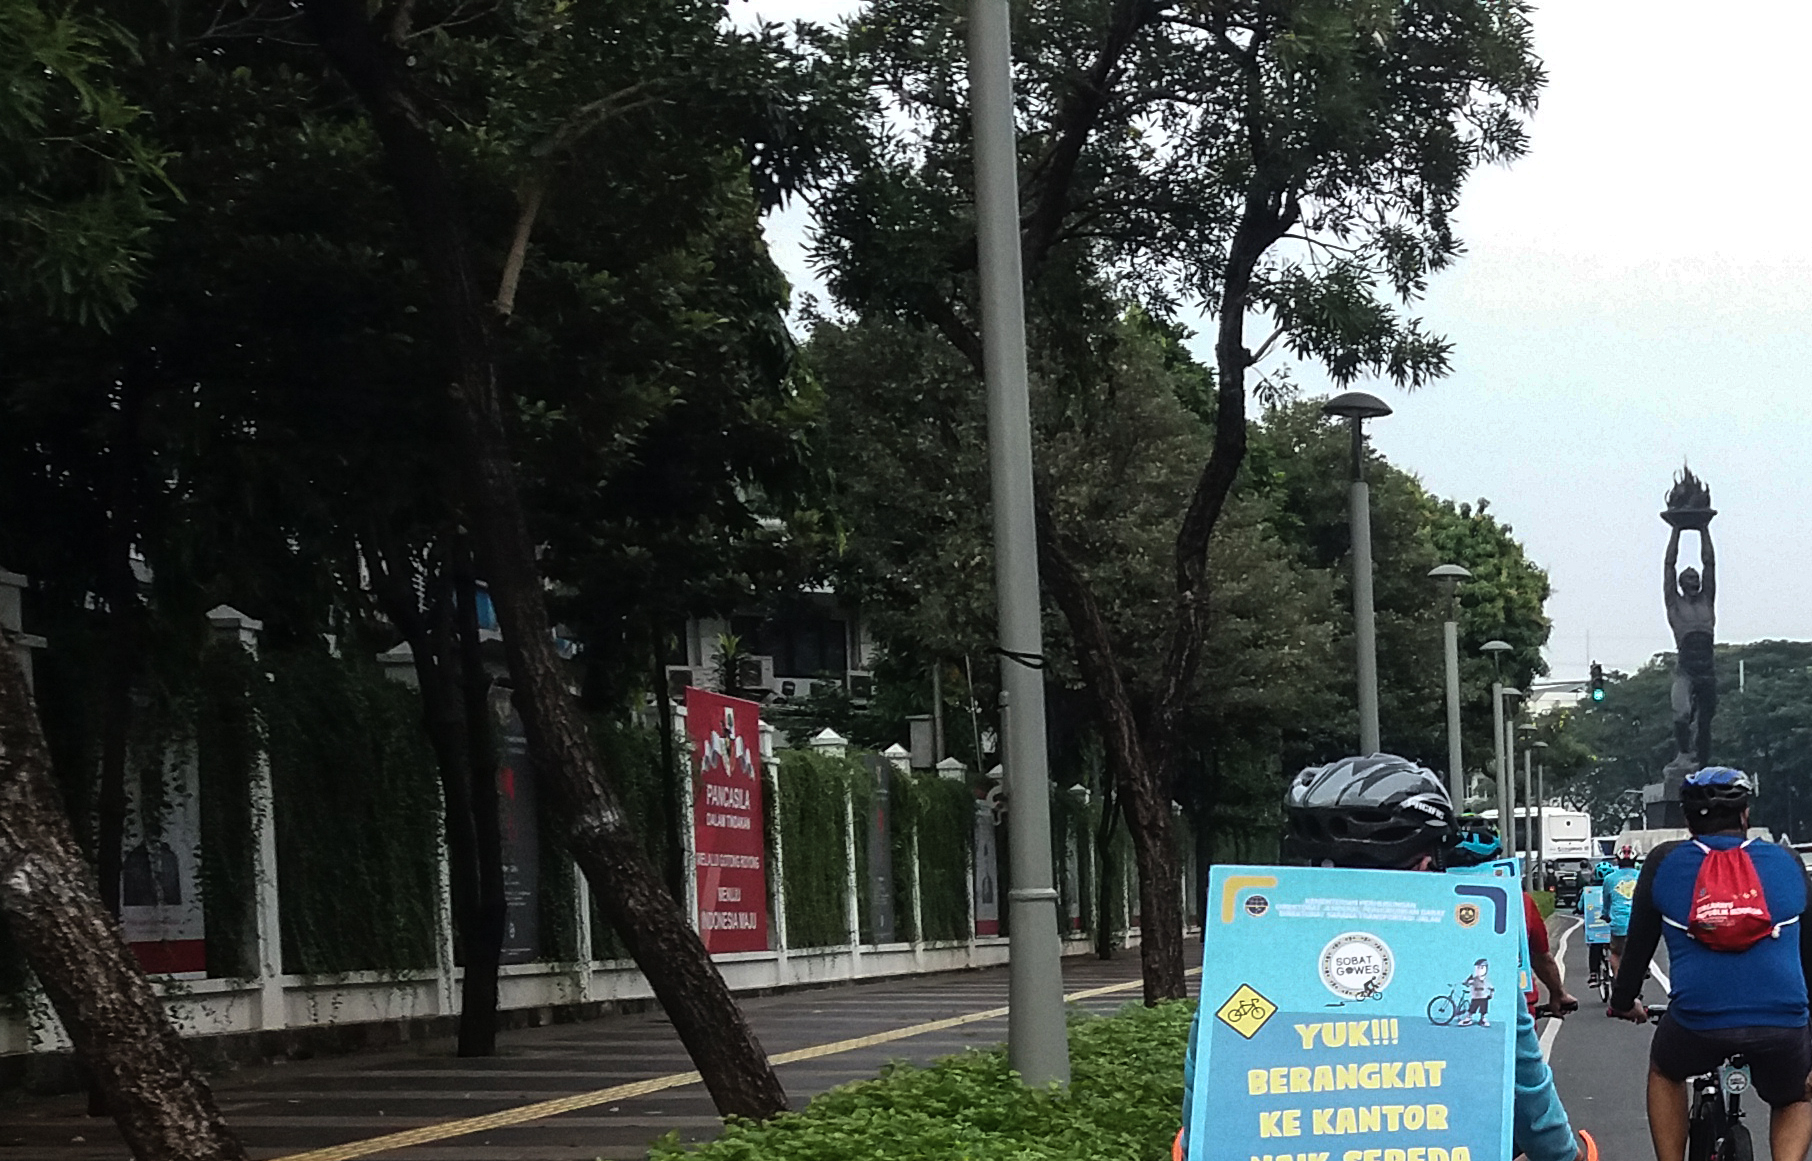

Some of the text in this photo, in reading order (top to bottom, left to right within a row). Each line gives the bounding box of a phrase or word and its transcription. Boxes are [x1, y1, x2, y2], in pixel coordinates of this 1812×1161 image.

[706, 784, 751, 809] PANCASILA
[1336, 955, 1372, 966] SOBAT
[1336, 965, 1380, 976] GOWES
[1294, 1018, 1399, 1051] YUK!!!
[1247, 1060, 1447, 1096] BERANGKAT
[1259, 1104, 1449, 1138] KE KANTOR
